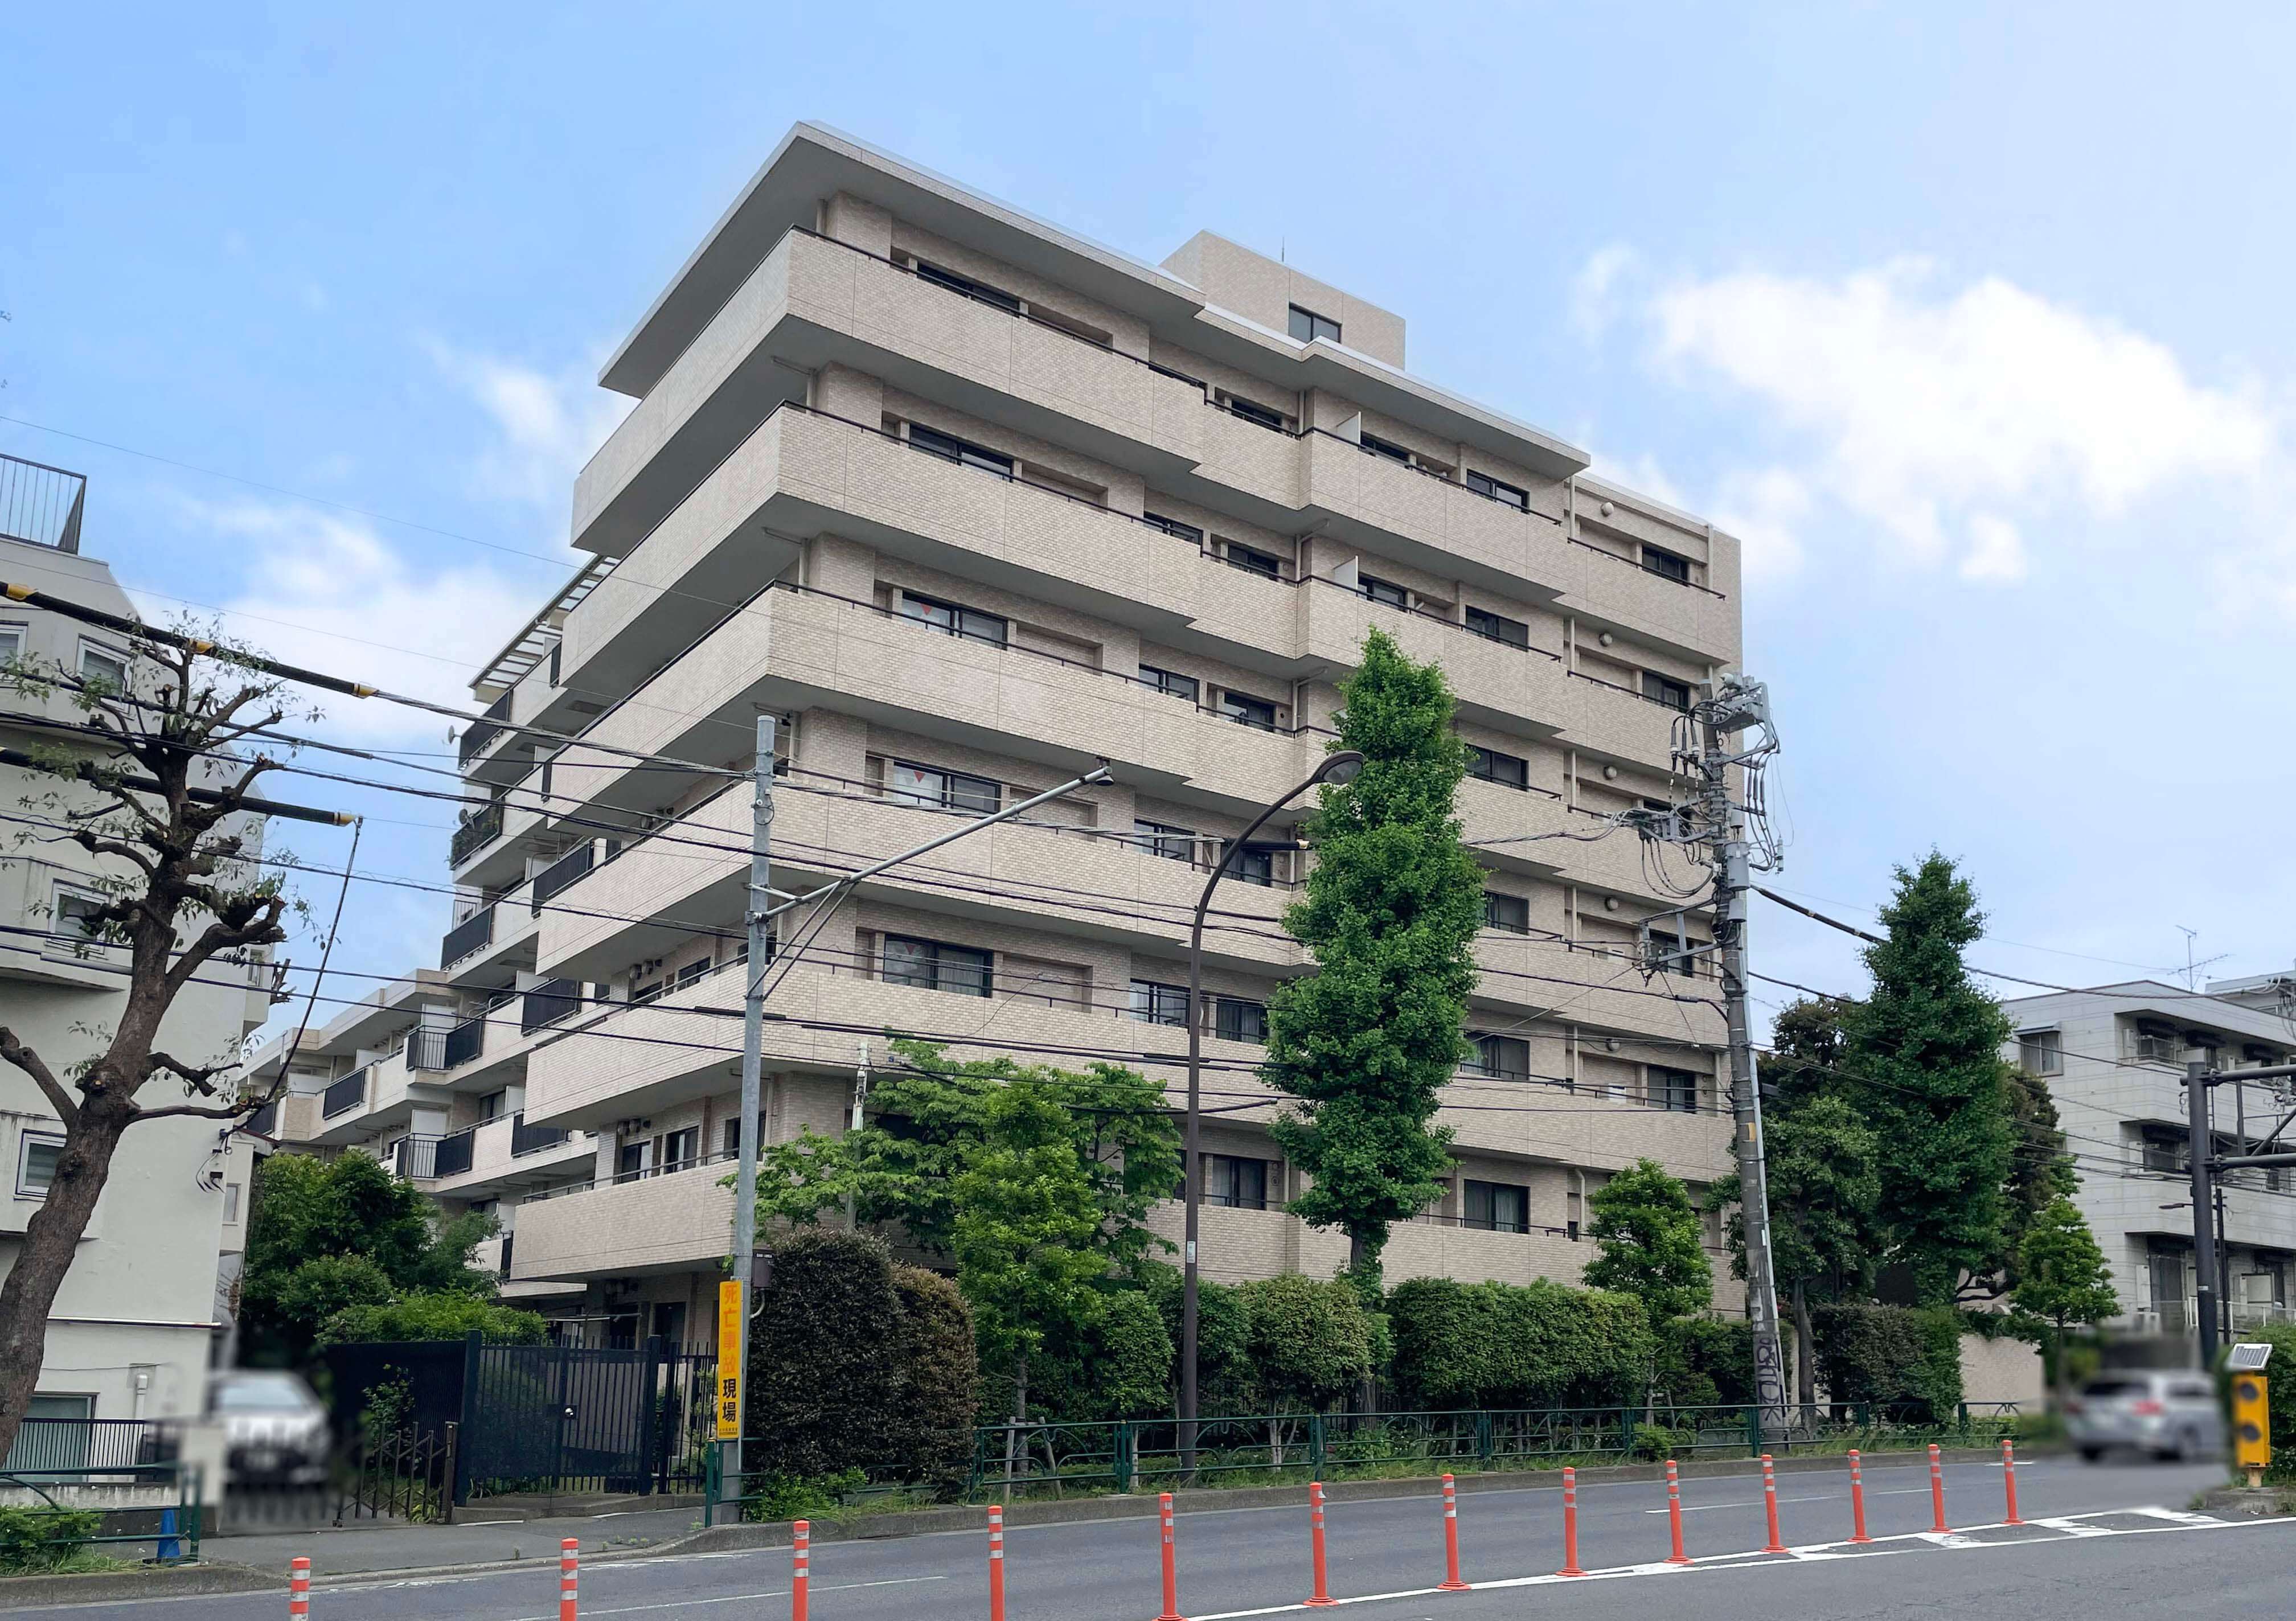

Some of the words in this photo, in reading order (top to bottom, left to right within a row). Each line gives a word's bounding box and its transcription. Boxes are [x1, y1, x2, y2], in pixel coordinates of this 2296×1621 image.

[722, 1284, 737, 1422] 死亡事故現場
